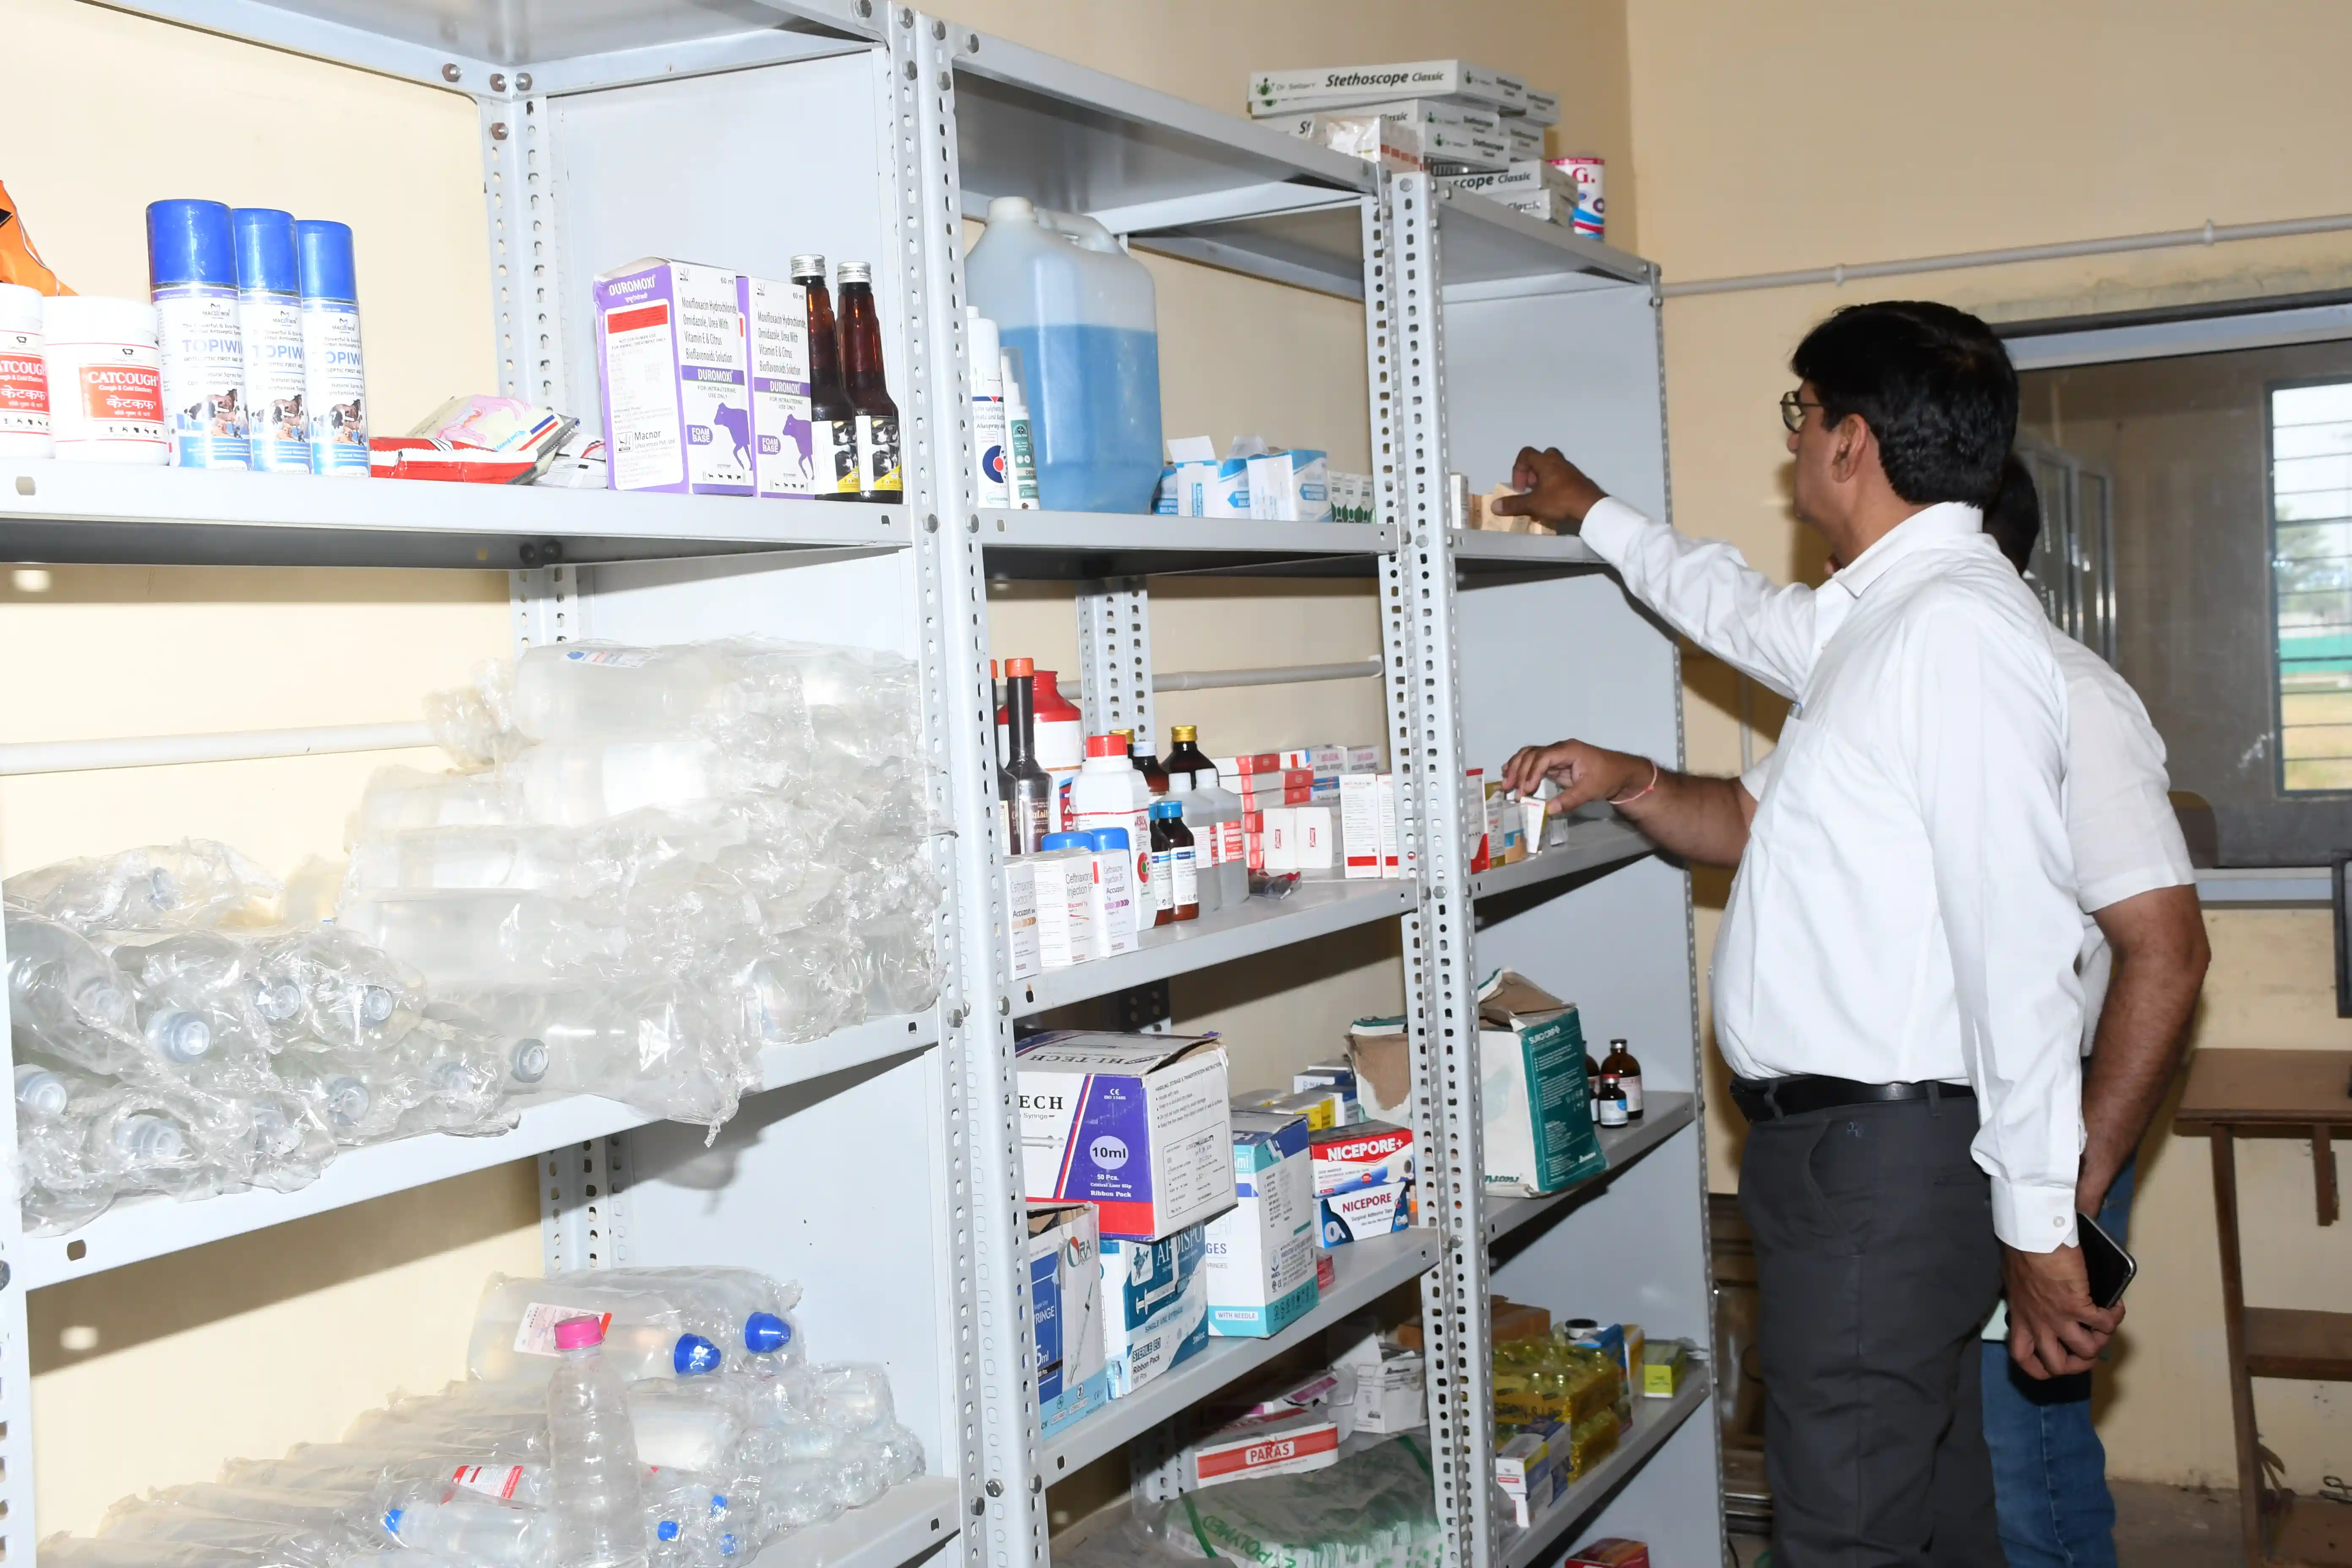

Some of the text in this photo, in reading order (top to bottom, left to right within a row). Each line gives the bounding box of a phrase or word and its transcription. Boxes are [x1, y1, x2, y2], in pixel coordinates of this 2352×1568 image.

[1326, 72, 1409, 87] Stethoscope
[1412, 71, 1444, 82] Classic
[1451, 171, 1531, 190] scope Classic
[609, 277, 655, 296] DUROMOXI
[682, 297, 709, 311] Moxifloxacin
[683, 314, 729, 329] Ornidazole, Urea With
[757, 310, 781, 324] Moxifloxacin
[684, 331, 722, 346] Vitamin E & Citrus
[758, 328, 798, 343] Ornidazole, Urea With
[182, 339, 242, 354] TOPIWI
[759, 343, 792, 358] Vitamin E & Citrus
[686, 348, 732, 362] Bioflavonoids Solution
[760, 360, 800, 375] Bioflavonoids Solution
[88, 371, 157, 386] CATCOUGH
[698, 369, 732, 383] DUROMOXI
[1, 385, 46, 400] केटकफ
[770, 381, 800, 394] DUROMOXI
[106, 395, 153, 409] केटकफ
[634, 431, 661, 442] Macnor
[691, 427, 710, 436] FOAM
[635, 441, 658, 449] Lifesciences
[692, 435, 710, 443] BASE
[762, 445, 778, 453] BASE
[1103, 866, 1123, 874] Ceftriaxone
[1066, 871, 1093, 885] Ceftriaxone
[1010, 879, 1033, 893] Ceftriaxone
[1067, 883, 1093, 898] Injection IP
[1106, 886, 1124, 894] Accuzon
[1013, 908, 1031, 917] Accuzon
[1029, 1055, 1125, 1064] HI-TECH
[1170, 1078, 1181, 1086] STORAGE
[1019, 1095, 1063, 1110] ECH
[1092, 1147, 1126, 1158] 10ml
[1327, 1138, 1403, 1162] NICEPORE+
[1342, 1192, 1392, 1213] NICEPORE
[1351, 1214, 1367, 1222] Surgical
[1206, 1243, 1227, 1254] GES
[1145, 1321, 1160, 1333] SINGLE
[1133, 1343, 1152, 1361] STERILE
[1133, 1354, 1160, 1375] Ribbon Pack
[1250, 1444, 1289, 1462] PARAS
